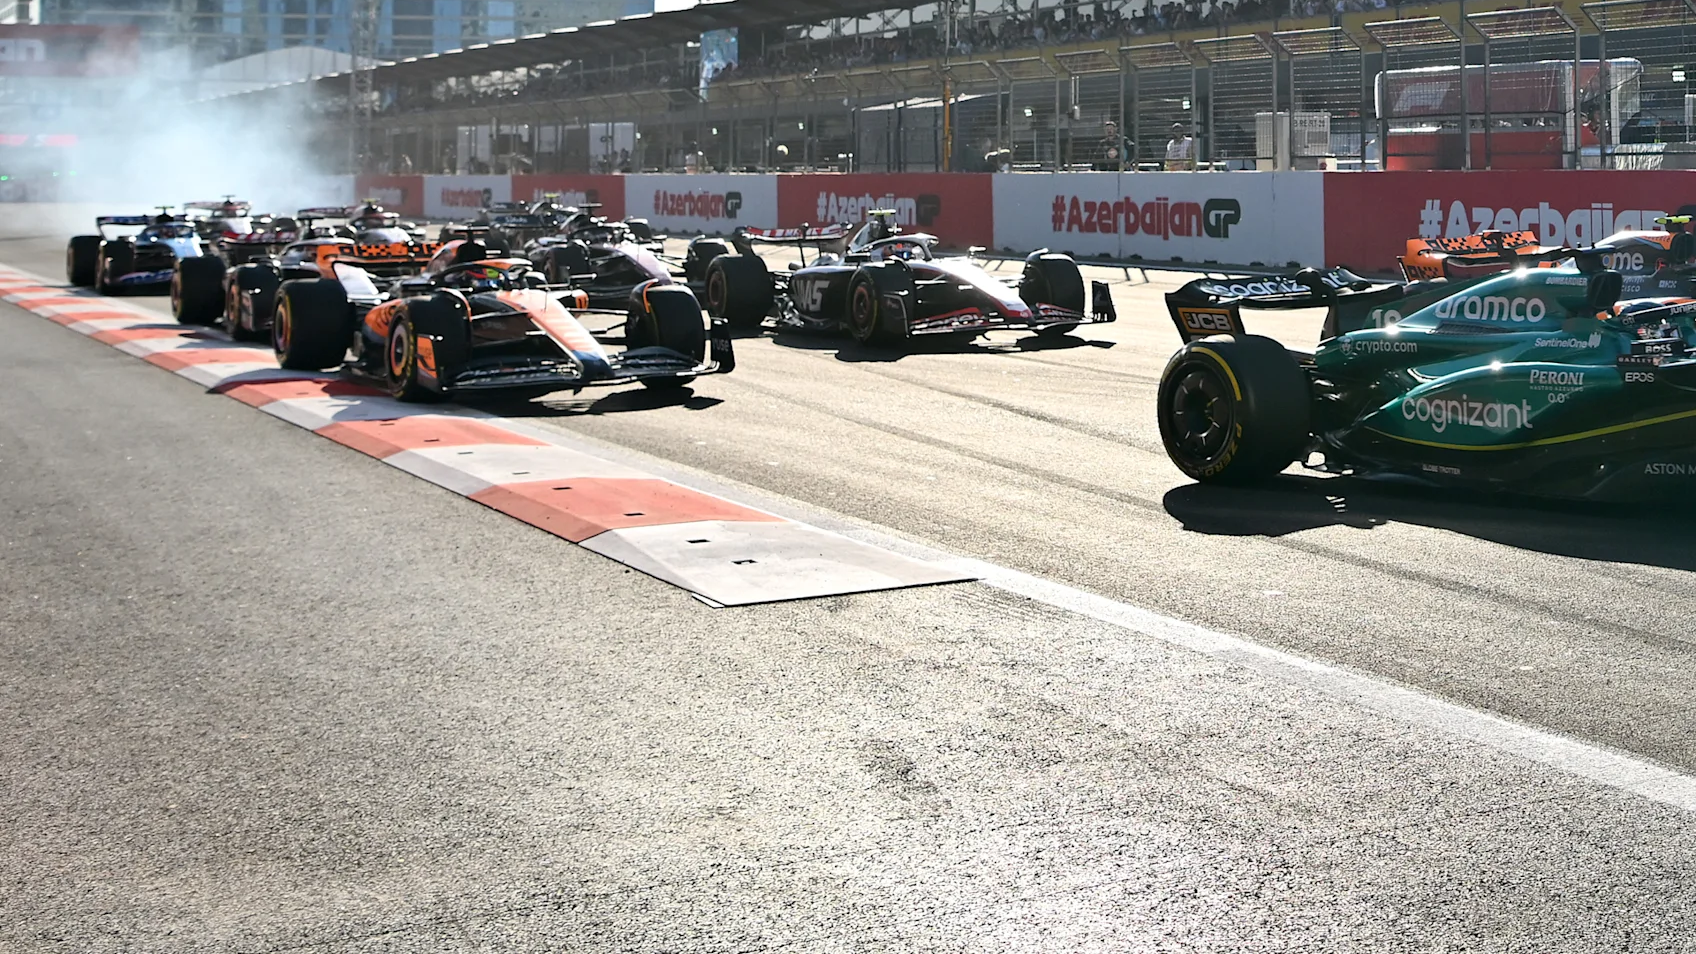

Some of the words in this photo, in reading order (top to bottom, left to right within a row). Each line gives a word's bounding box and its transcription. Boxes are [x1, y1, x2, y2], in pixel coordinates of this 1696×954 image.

[654, 189, 742, 221] #AzerbaijanGP
[1051, 194, 1241, 241] #AzerbaijanGP
[1201, 272, 1350, 297] cogniznt
[1435, 296, 1546, 323] aramco
[1187, 313, 1232, 331] JCB
[1356, 339, 1418, 354] crypto.com
[1535, 336, 1588, 349] SentinelOne
[1645, 343, 1672, 353] BOSS
[1530, 369, 1584, 385] PERONI
[1625, 372, 1655, 383] EPOS
[1401, 394, 1533, 433] cognizant
[1644, 462, 1685, 475] ASTON
